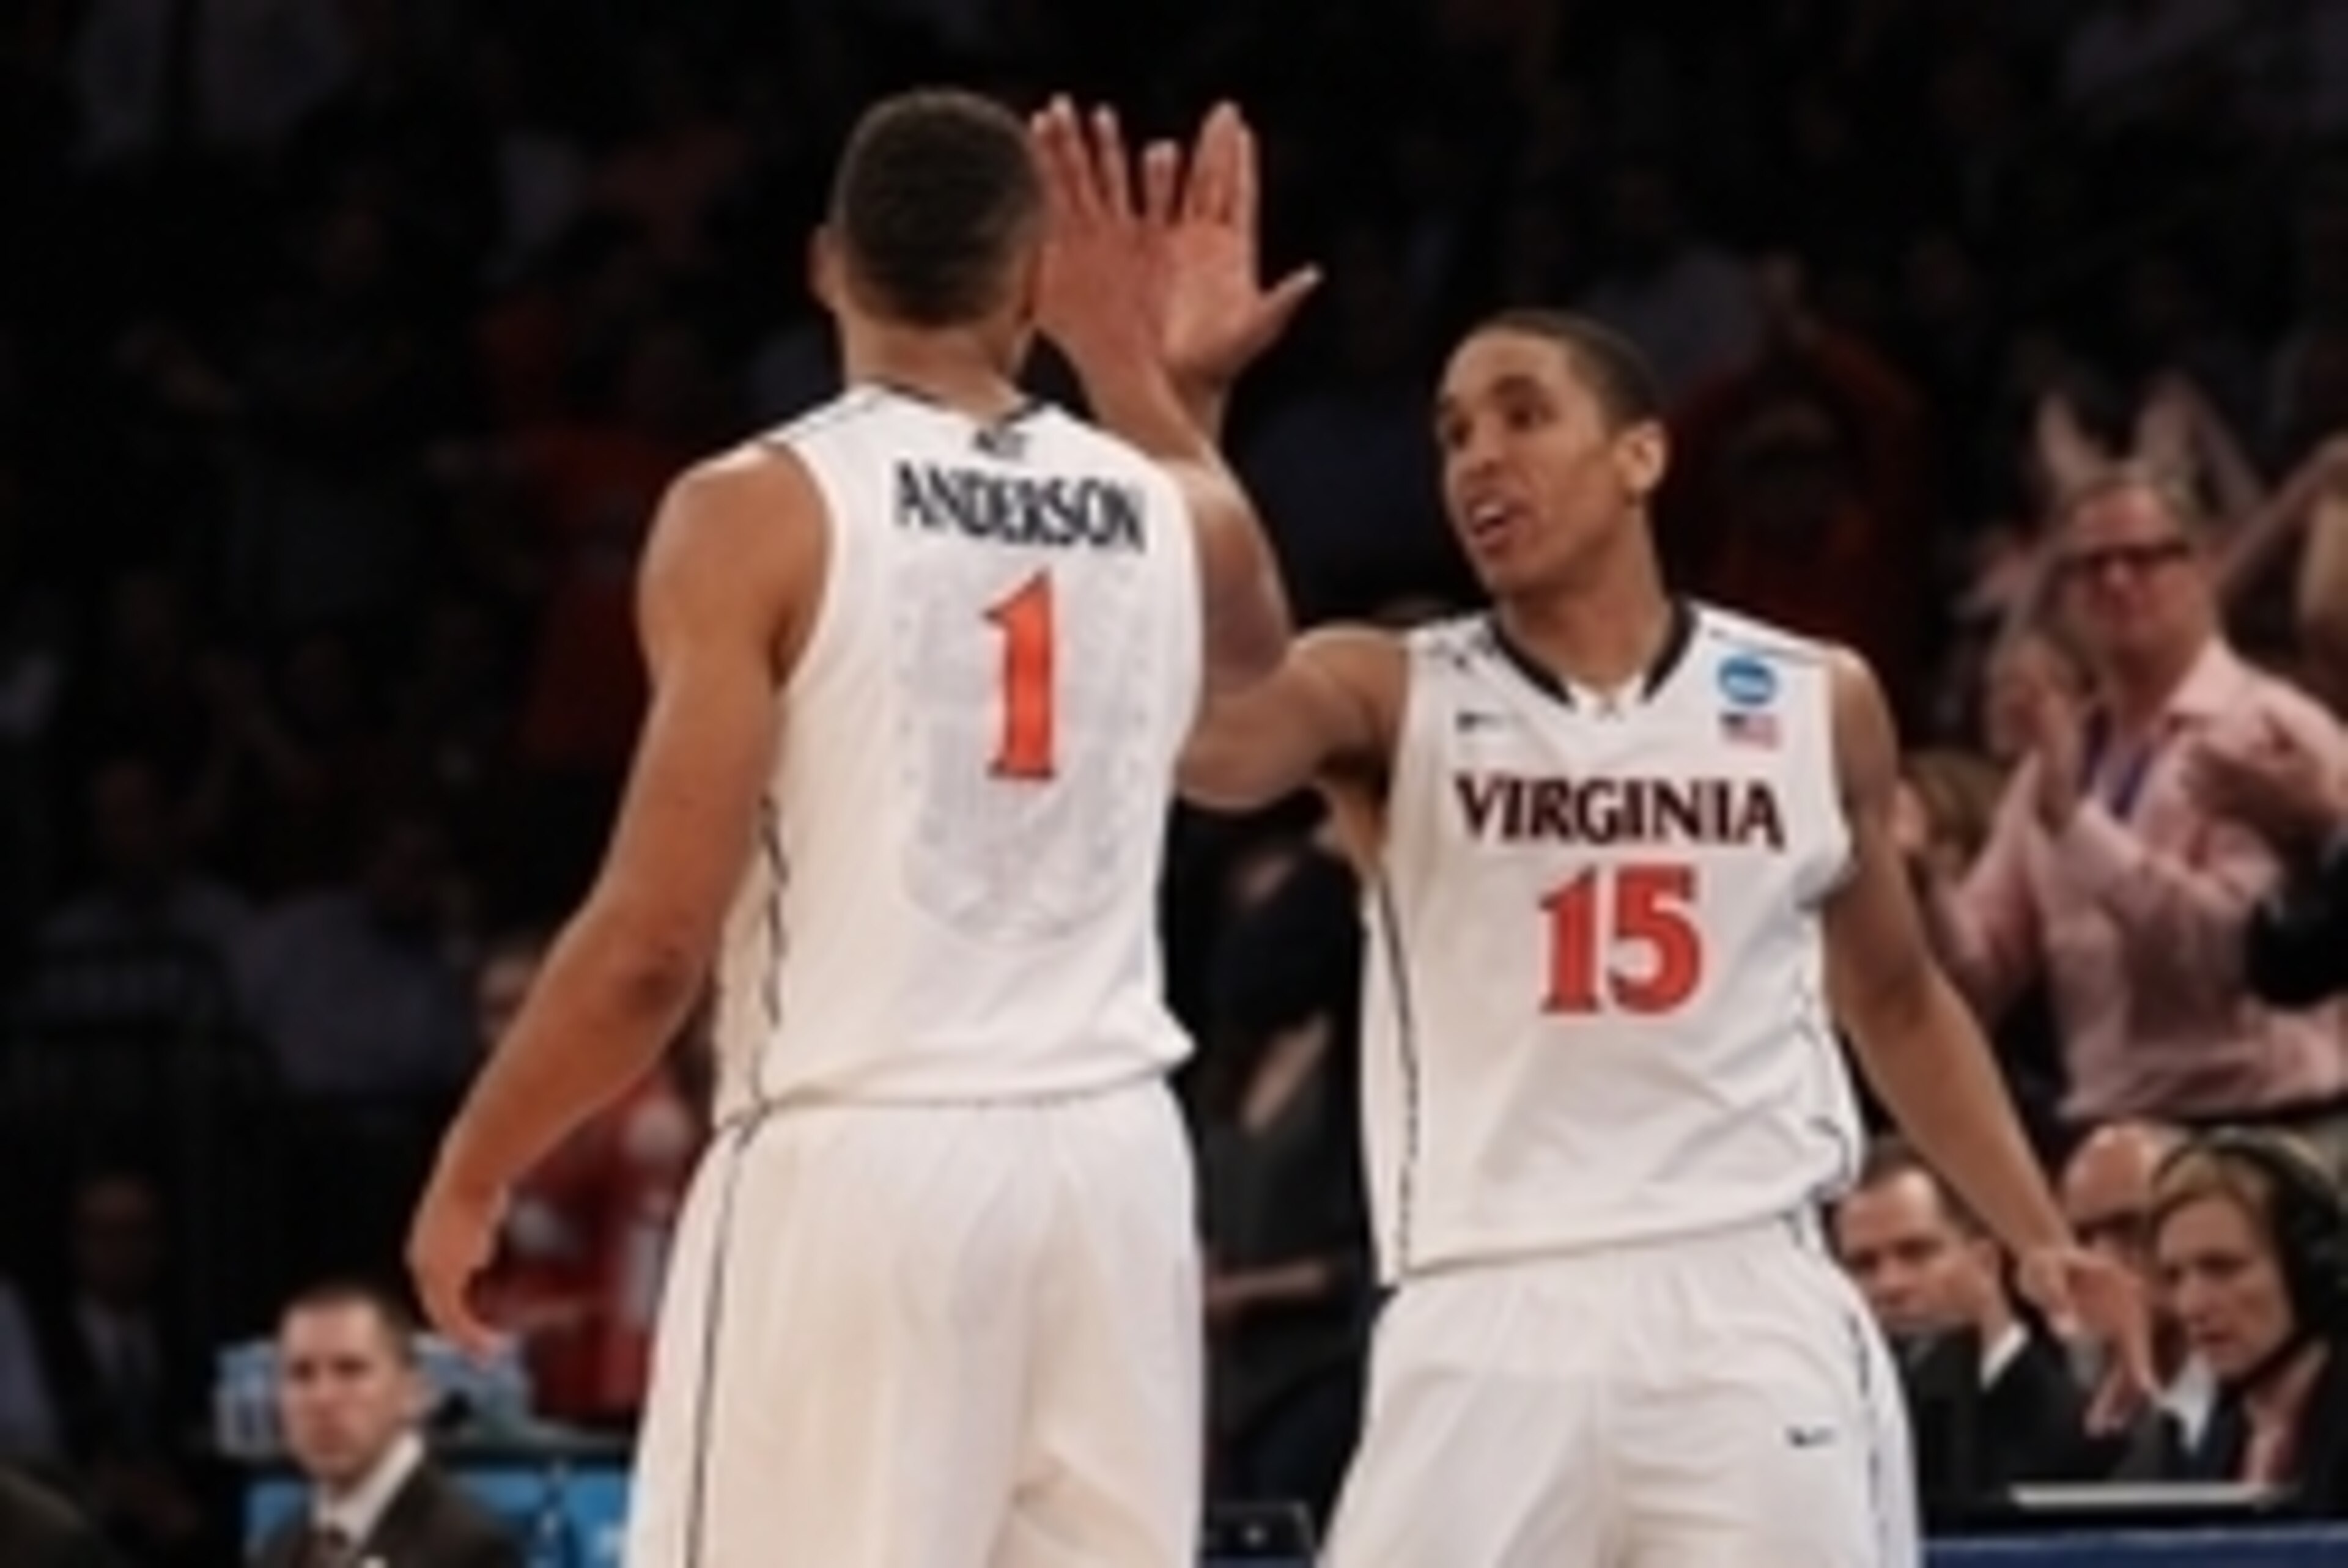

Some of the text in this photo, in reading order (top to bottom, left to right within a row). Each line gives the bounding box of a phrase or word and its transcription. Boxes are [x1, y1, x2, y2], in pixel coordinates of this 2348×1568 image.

[895, 460, 1146, 553] ANDERSON
[983, 569, 1057, 780] 1
[1455, 773, 1785, 852] VIRGINIA
[1540, 863, 1704, 1015] 15
